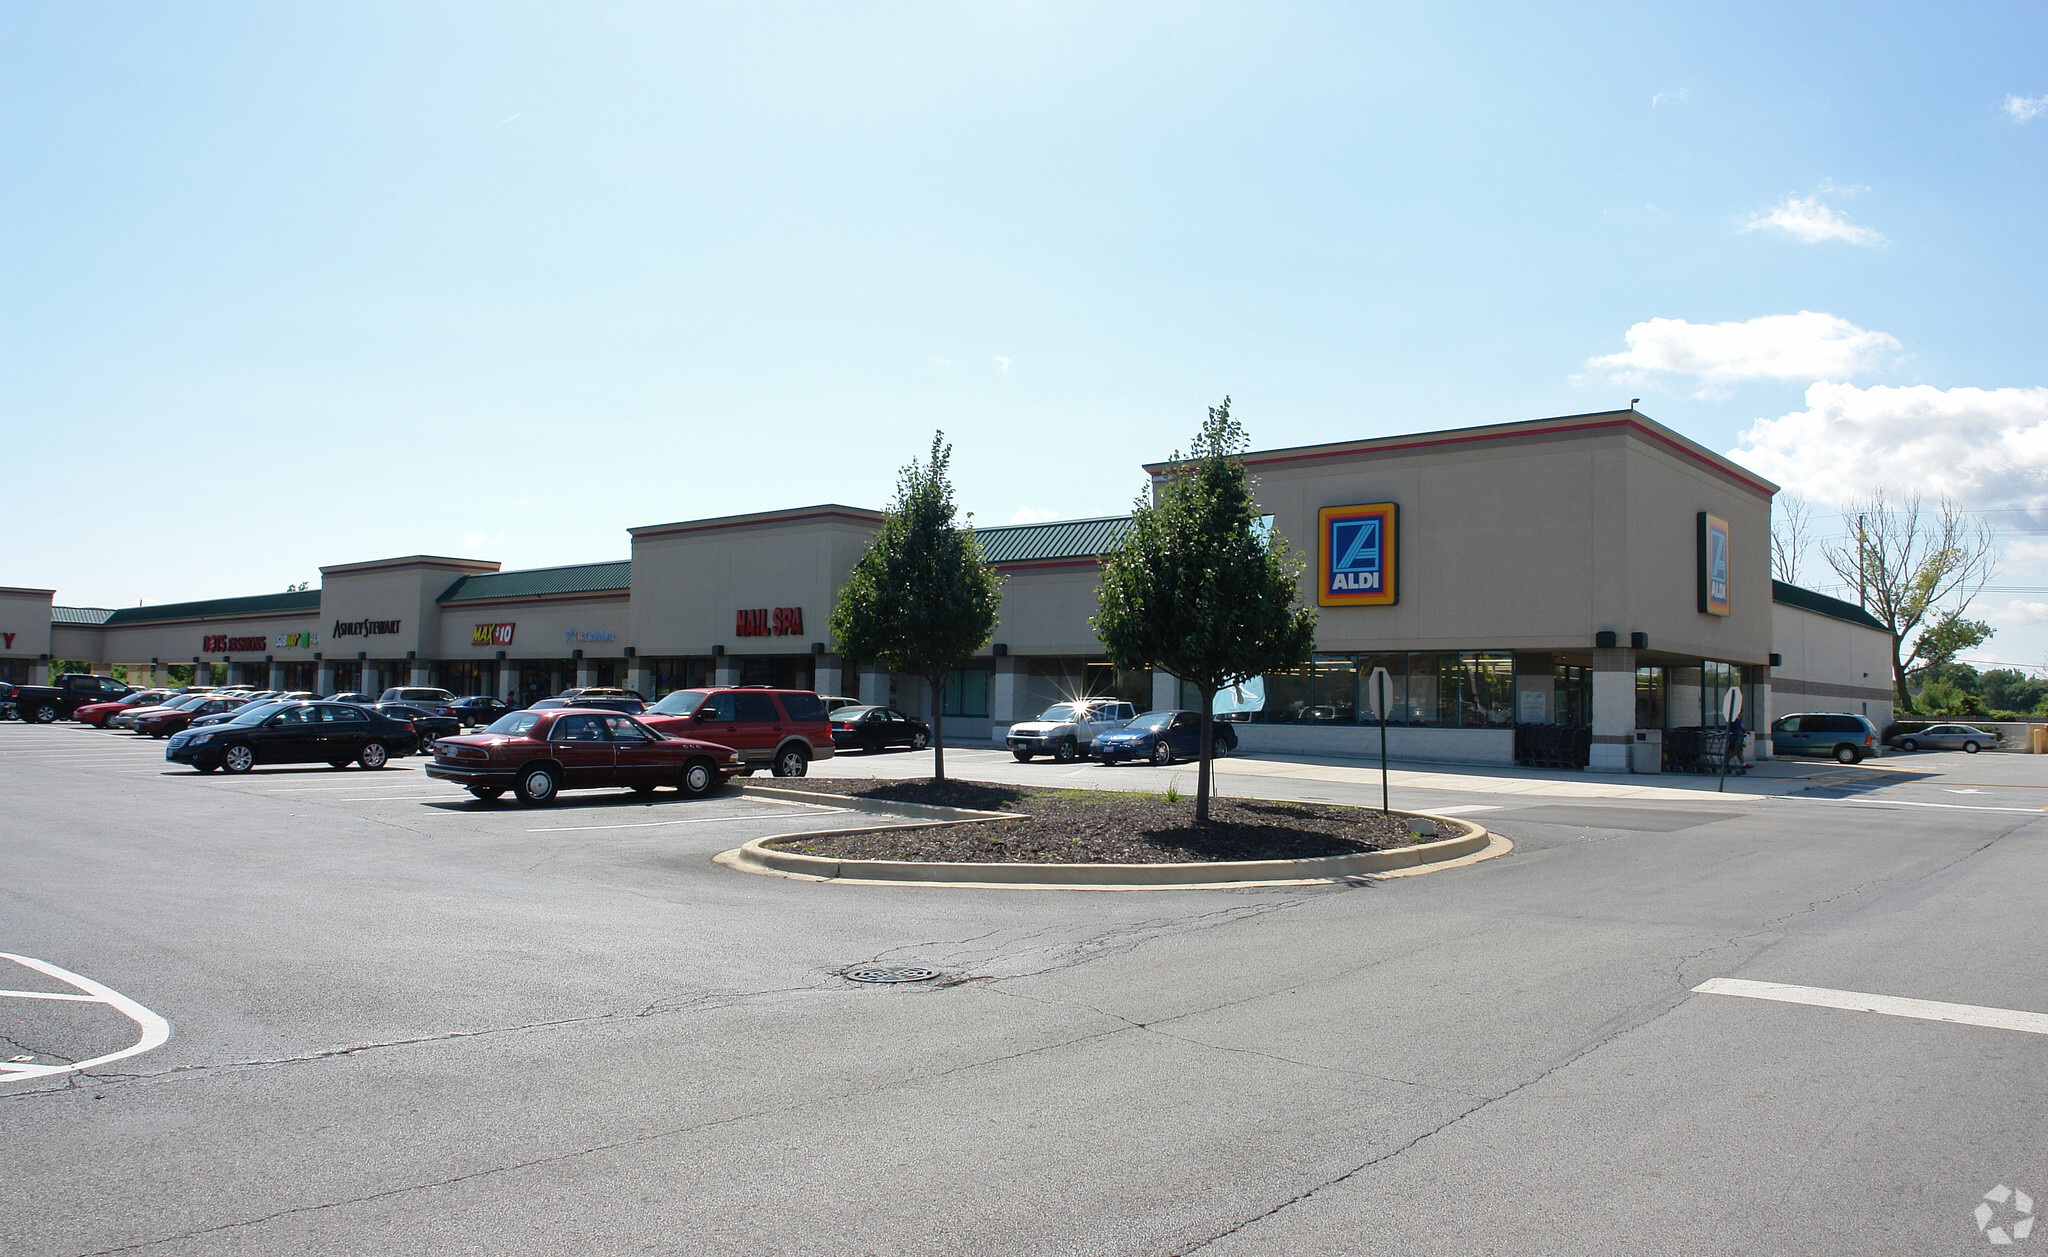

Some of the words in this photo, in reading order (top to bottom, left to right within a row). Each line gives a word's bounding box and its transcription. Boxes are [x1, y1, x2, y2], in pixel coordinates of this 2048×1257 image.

[1332, 572, 1379, 590] ALDI
[1711, 580, 1726, 599] ALDI
[736, 609, 771, 637] NAIL
[772, 607, 804, 636] SPA
[472, 624, 495, 645] MAX
[495, 625, 512, 643] $10
